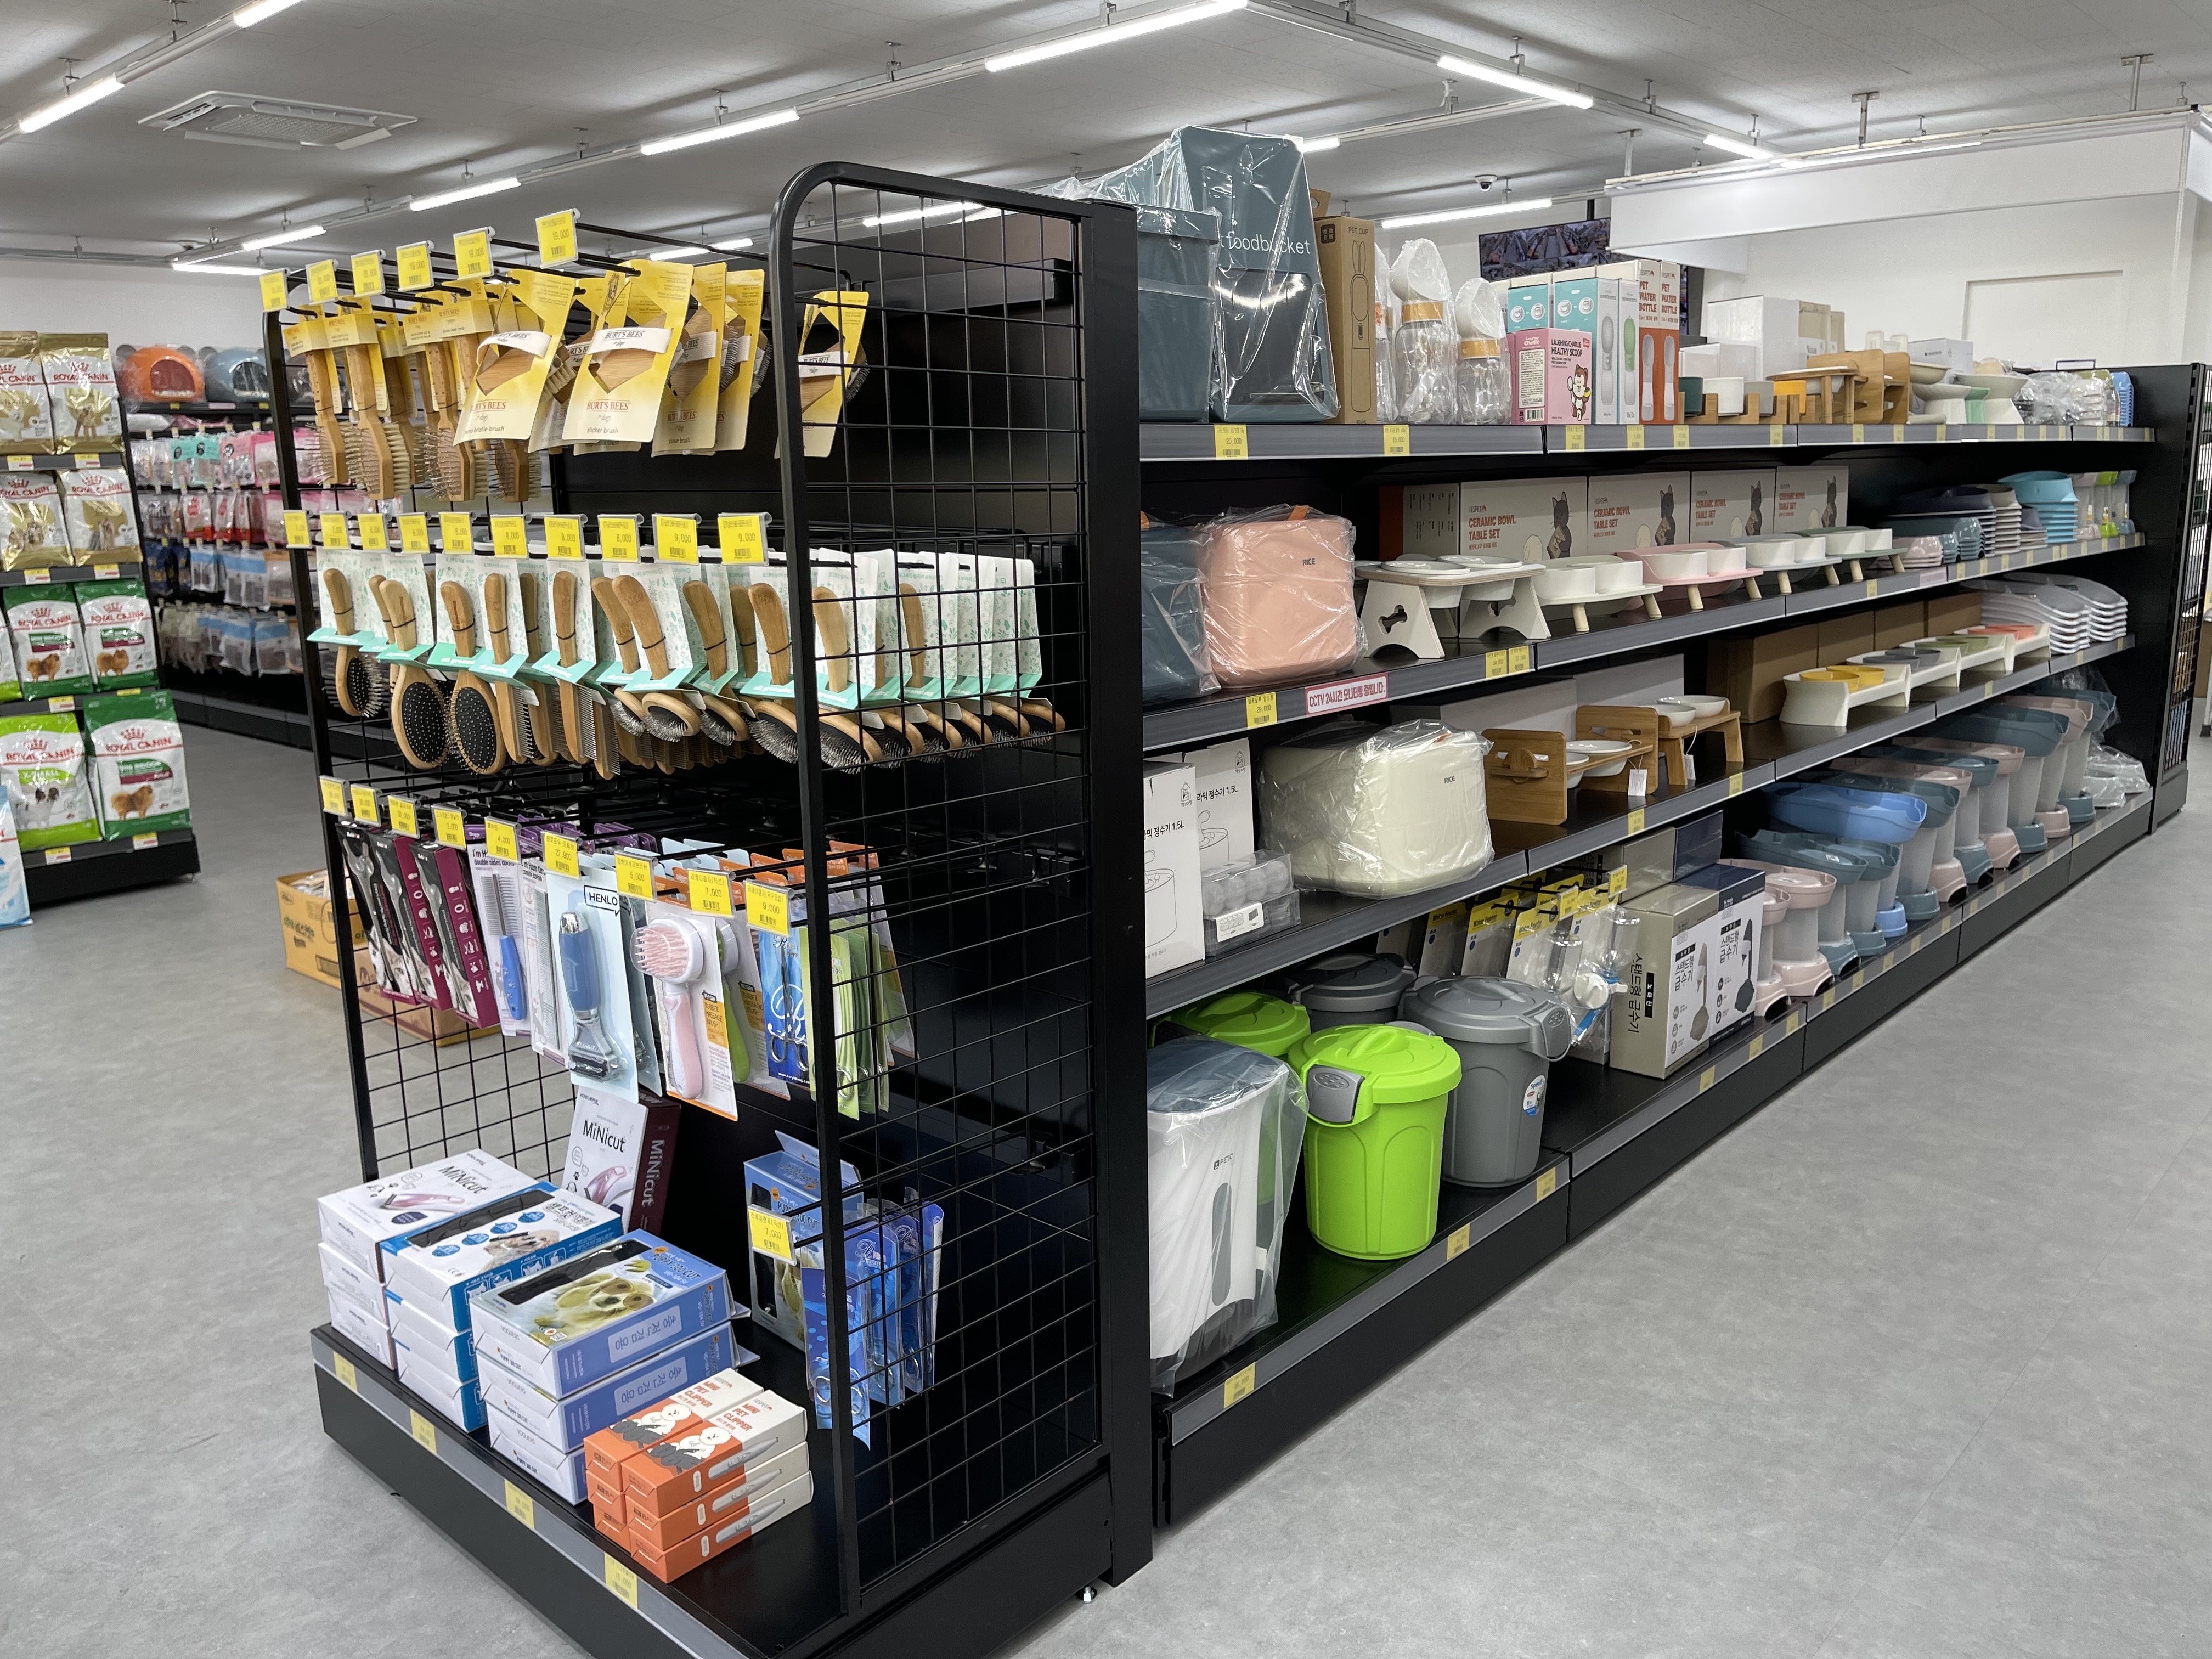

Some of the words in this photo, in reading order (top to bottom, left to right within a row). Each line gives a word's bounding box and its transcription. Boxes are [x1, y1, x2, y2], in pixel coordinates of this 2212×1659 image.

[552, 229, 569, 241] 19,000
[1639, 280, 1649, 290] PET
[1661, 283, 1670, 292] PET
[1639, 292, 1656, 302] WATER
[1661, 294, 1677, 304] WATER
[1639, 303, 1657, 313] BOTTLE
[1661, 304, 1678, 314] BOTTLE
[605, 330, 625, 339] BURT'S
[1551, 338, 1568, 347] LAUGHING
[1568, 340, 1582, 348] CHARLIE
[1551, 347, 1569, 356] HEALTHY
[1570, 348, 1583, 357] SCOOP
[488, 401, 506, 410] BEES
[586, 402, 608, 410] BURT'S
[610, 402, 629, 410] BEES
[1226, 437, 1242, 445] 20,000
[1696, 500, 1714, 509] CERAMIC
[1714, 498, 1726, 507] BOWL
[1594, 507, 1615, 518] CERAMIC
[1616, 506, 1630, 516] BOWL
[1695, 511, 1708, 520] TABLE
[1708, 510, 1716, 518] SET
[1468, 516, 1497, 528] CERAMIC
[1497, 514, 1516, 526] BOWL
[1593, 521, 1609, 530] TABLE
[1609, 518, 1618, 528] SET
[561, 533, 575, 543] 8,000
[616, 533, 631, 543] 8,000
[674, 533, 691, 543] 9,000
[738, 533, 756, 543] 9,000
[1468, 529, 1487, 541] TABLE
[1488, 528, 1500, 539] SET
[1302, 558, 1316, 566] RICE
[1309, 693, 1324, 708] CCTV
[1325, 690, 1342, 704] 24시간
[1343, 685, 1363, 701] 모니터링
[1364, 681, 1386, 697] 중입니다.
[1256, 704, 1272, 713] 29,000
[1444, 775, 1455, 783] RICE
[1197, 789, 1208, 803] 라믹
[1209, 787, 1225, 800] 정수기
[1226, 785, 1238, 795] 1.5L
[1153, 823, 1171, 837] 정수기
[1171, 820, 1184, 831] 1.5L
[498, 836, 510, 845] 4,000
[555, 849, 572, 861] 27,900
[489, 857, 501, 866] sides
[630, 871, 645, 882] 5,000
[704, 887, 723, 898] 7,000
[589, 891, 618, 906] HENLO
[762, 901, 780, 915] 9,000
[1720, 929, 1740, 948] 스탠드형
[1720, 945, 1739, 964] 급수기
[1675, 954, 1695, 975] 스탠드형
[1629, 953, 1643, 997] 스탠드형
[1674, 969, 1694, 992] 급수기
[1627, 1000, 1641, 1034] 급수기
[583, 1119, 625, 1153] MiNicut
[641, 1139, 665, 1208] MiNicut
[438, 1166, 488, 1194] MiNicut
[765, 1228, 782, 1239] 7,000
[693, 1385, 710, 1395] PET
[703, 1381, 721, 1392] MINI
[684, 1390, 713, 1408] CLIPPER
[732, 1408, 749, 1417] PET
[742, 1403, 761, 1414] MINI
[723, 1412, 753, 1432] CLIPPER
